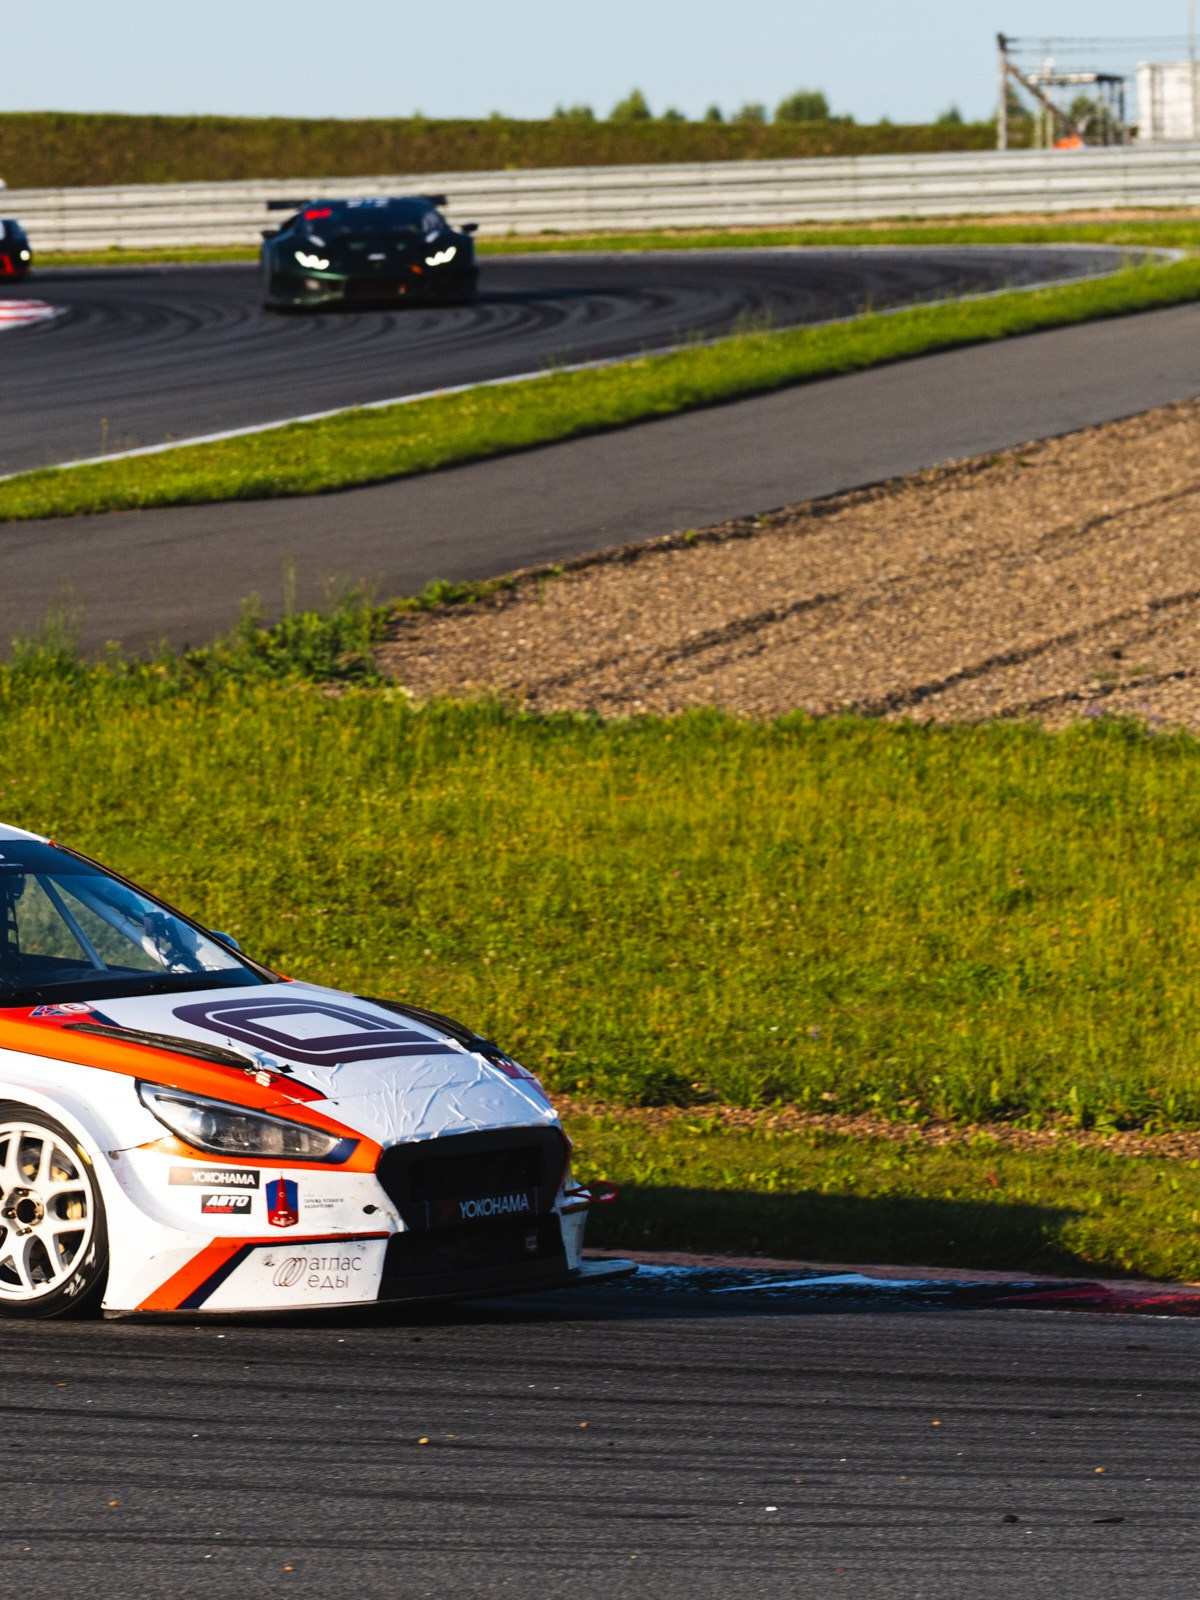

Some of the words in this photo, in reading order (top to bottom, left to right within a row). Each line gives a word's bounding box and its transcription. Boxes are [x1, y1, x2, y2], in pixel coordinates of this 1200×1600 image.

[192, 1171, 256, 1186] YOKOHAMA
[460, 1193, 529, 1218] YOKOHAMA
[308, 1256, 362, 1271] атлас
[308, 1274, 350, 1289] еды
